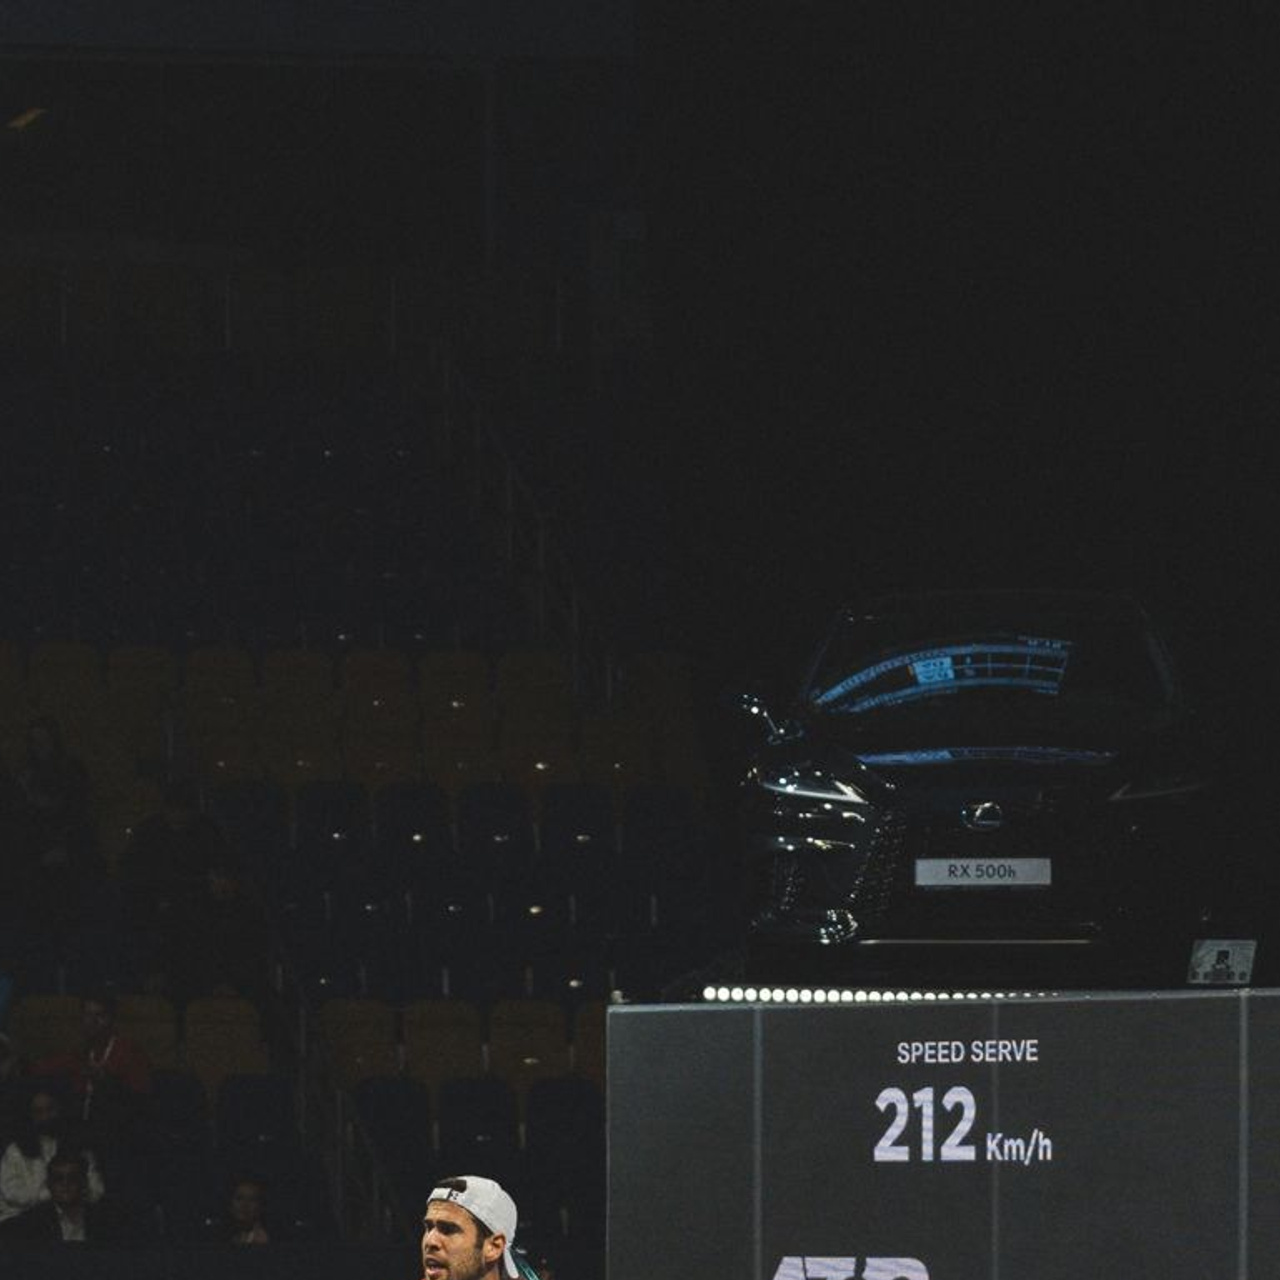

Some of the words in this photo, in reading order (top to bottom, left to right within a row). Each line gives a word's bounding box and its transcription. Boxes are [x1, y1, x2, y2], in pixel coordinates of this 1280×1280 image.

[948, 864, 971, 879] RX
[975, 864, 1017, 879] 500h
[897, 1040, 966, 1064] SPEED
[970, 1039, 1039, 1063] SERVE
[873, 1086, 977, 1162] 212
[986, 1129, 1052, 1166] Km/h
